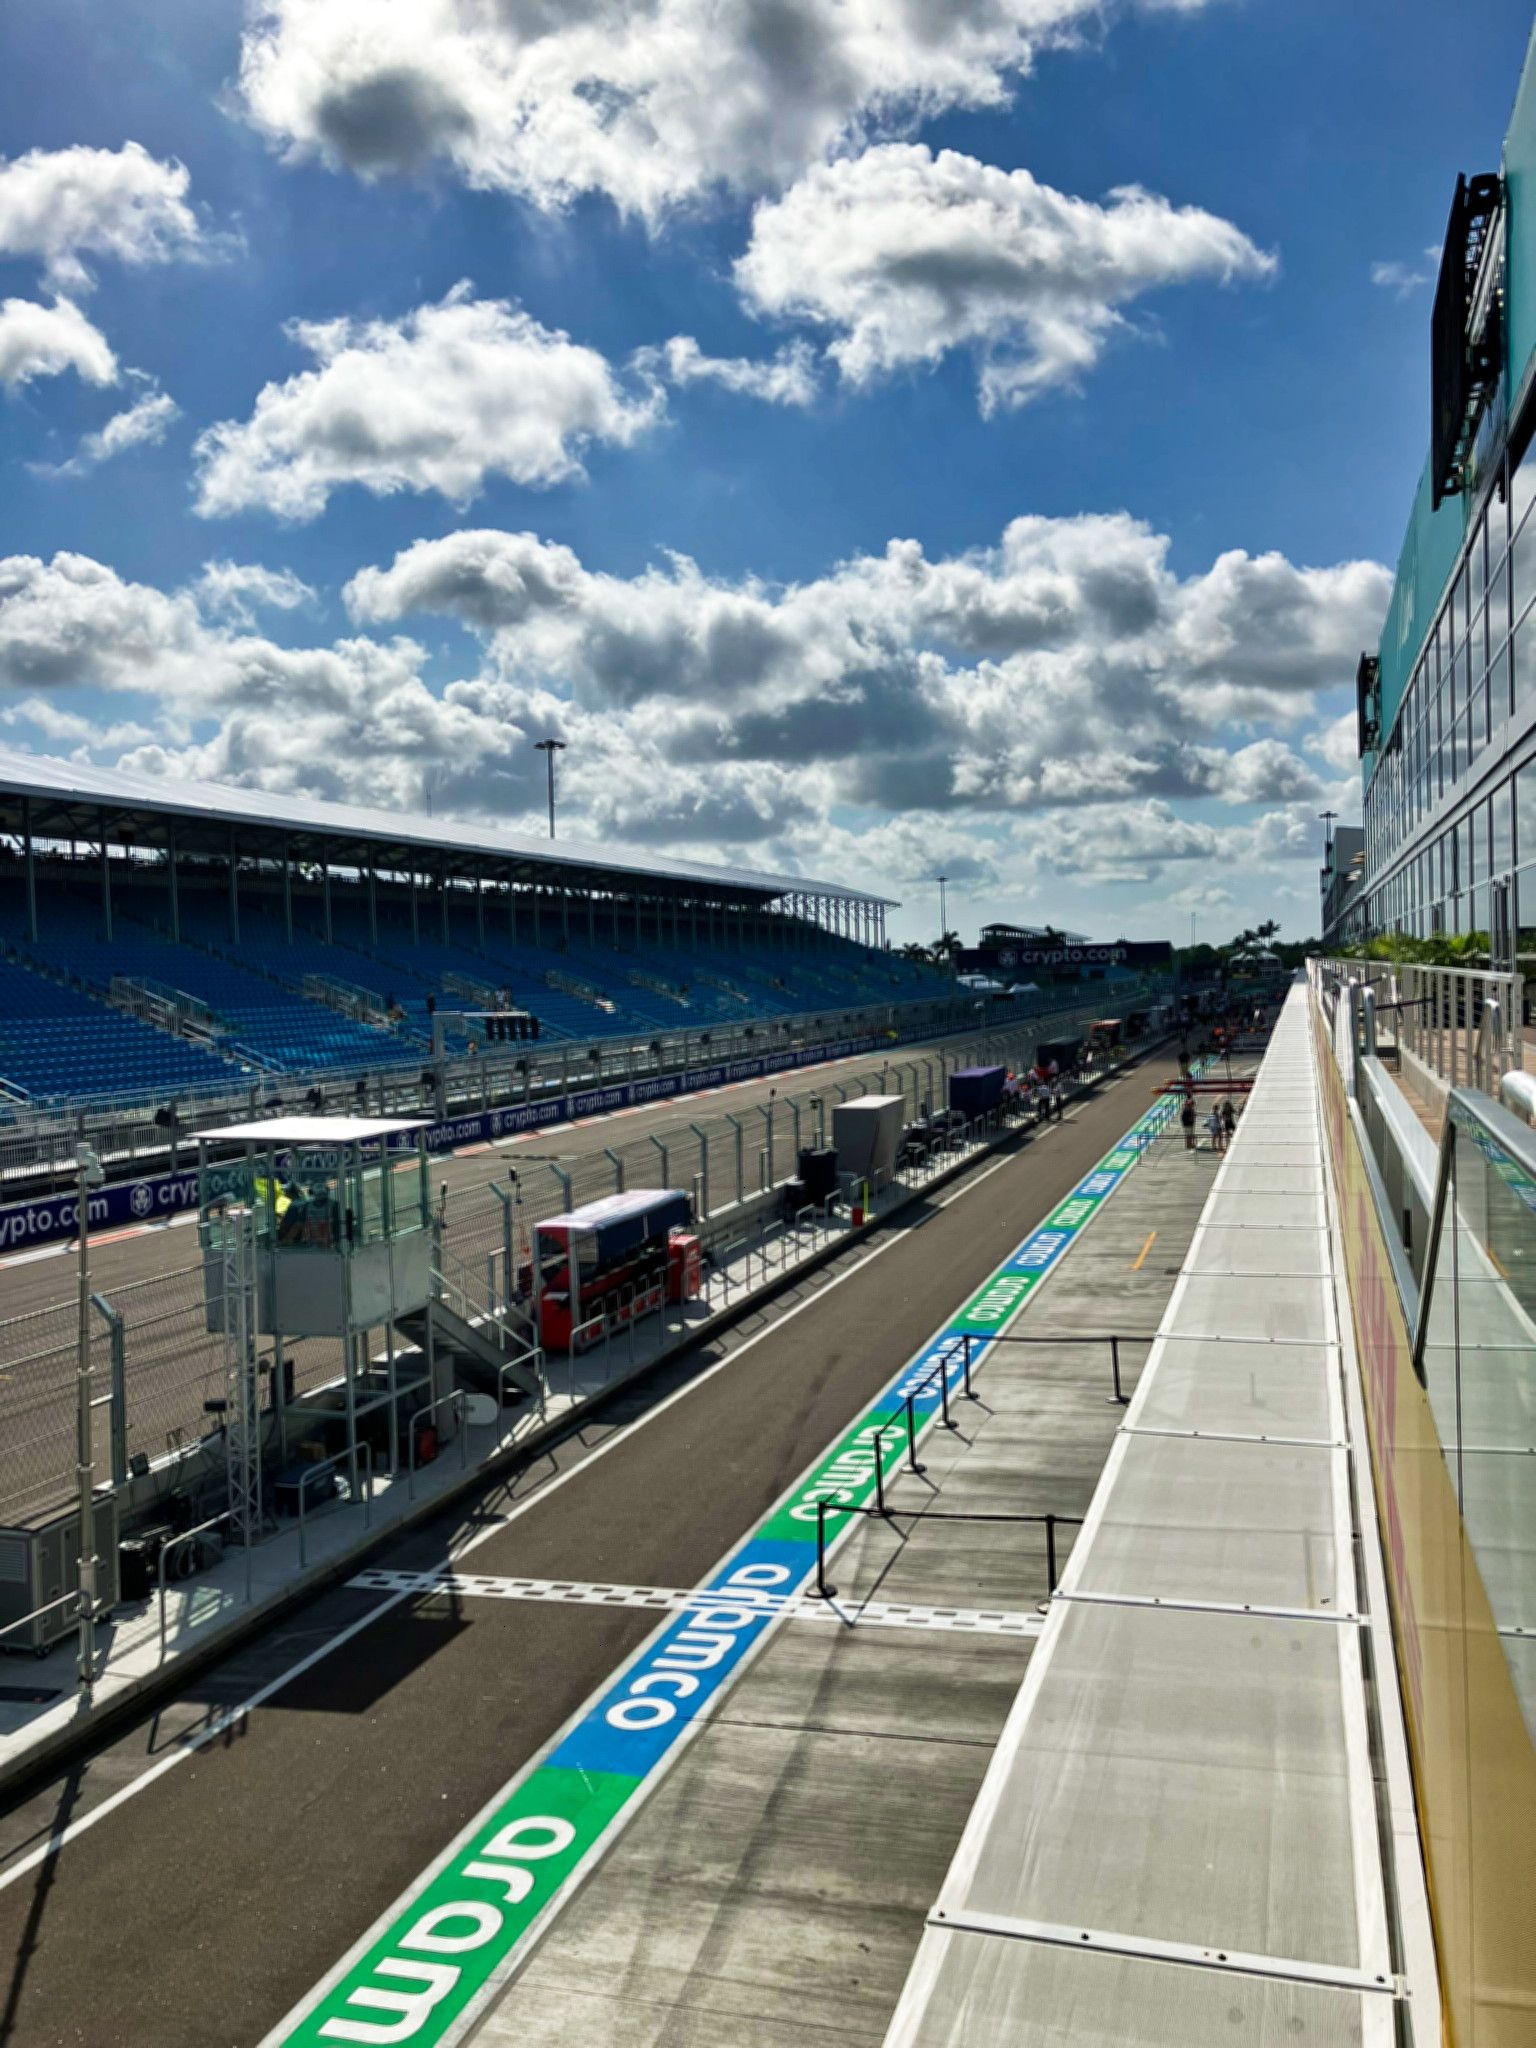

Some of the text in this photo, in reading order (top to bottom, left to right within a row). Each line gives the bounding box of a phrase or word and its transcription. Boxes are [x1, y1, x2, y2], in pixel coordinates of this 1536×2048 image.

[1022, 946, 1127, 964] crypto.com
[578, 1091, 620, 1112] crypto.com
[636, 1080, 674, 1099] crypto.com
[504, 1104, 559, 1129] crypto.com
[966, 1276, 1030, 1321] aramco
[789, 1425, 906, 1521] aramco
[605, 1563, 791, 1731] aramco
[317, 1815, 576, 2045] aram
